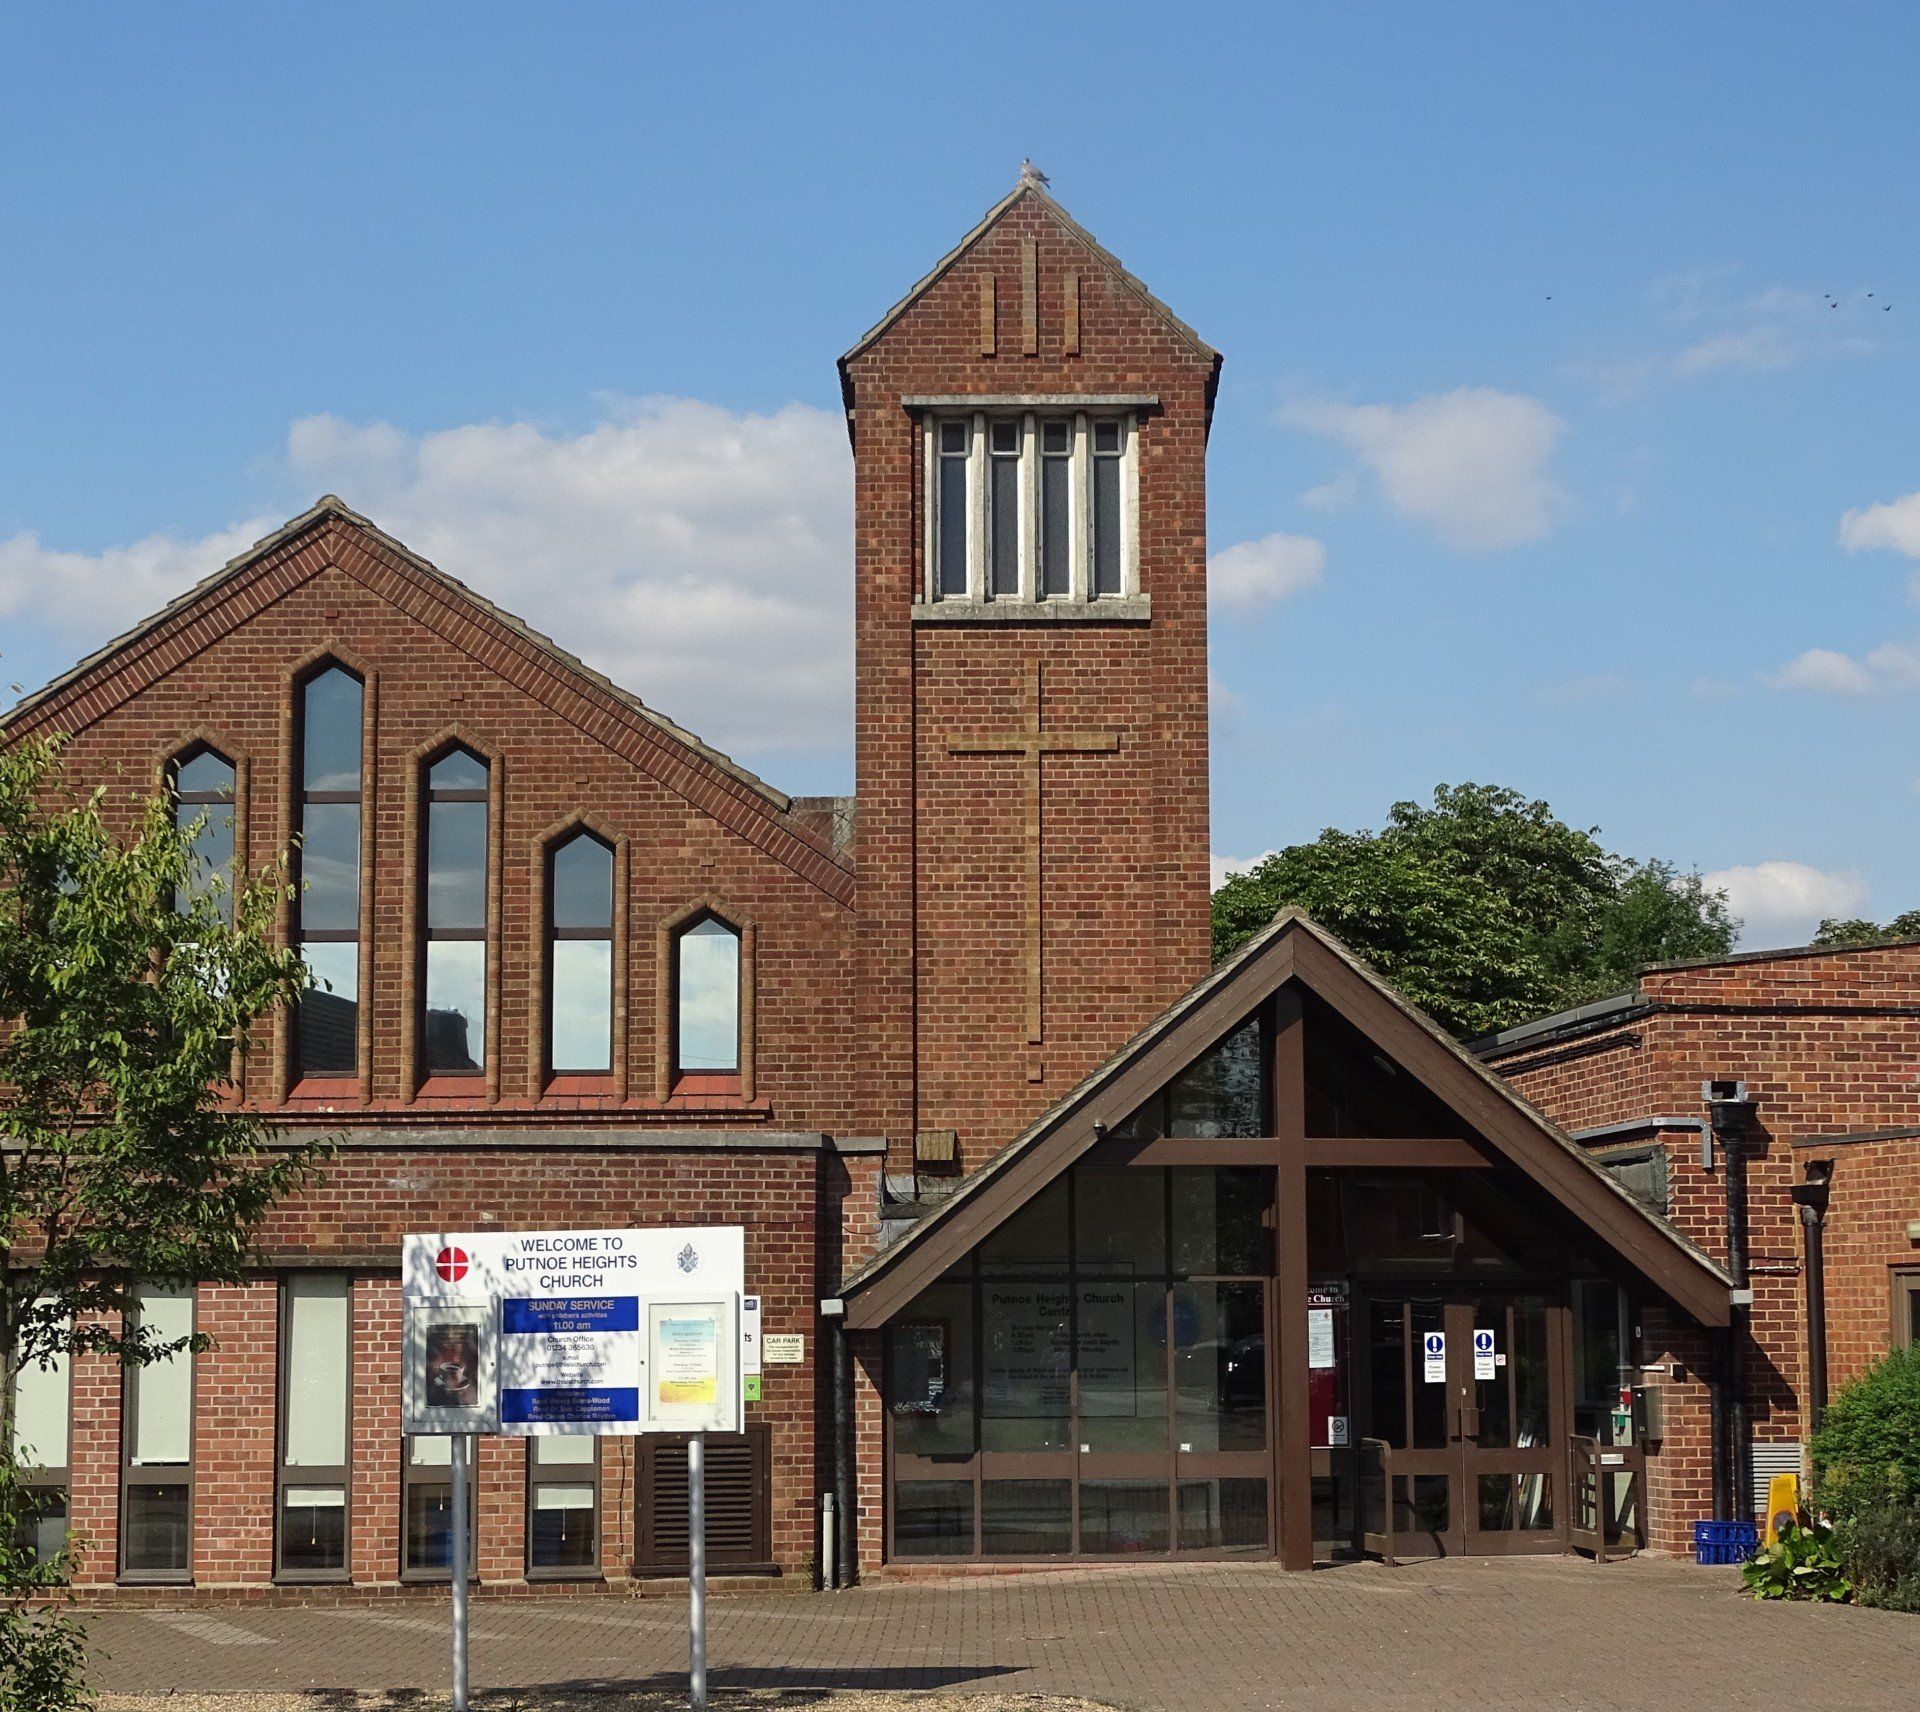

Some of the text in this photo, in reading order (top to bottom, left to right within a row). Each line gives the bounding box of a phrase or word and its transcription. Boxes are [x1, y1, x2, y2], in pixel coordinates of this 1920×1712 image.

[521, 1237, 622, 1252] WELCOME TO
[506, 1255, 637, 1270] PUTNOE HEIGHTS
[540, 1274, 603, 1288] CHURCH
[992, 1293, 1124, 1305] Putnoe Heigh Church
[1313, 1294, 1344, 1303] Church
[528, 1300, 614, 1311] SUNDAY SERVICE
[1038, 1306, 1071, 1316] Centr
[553, 1321, 574, 1330] 11.00
